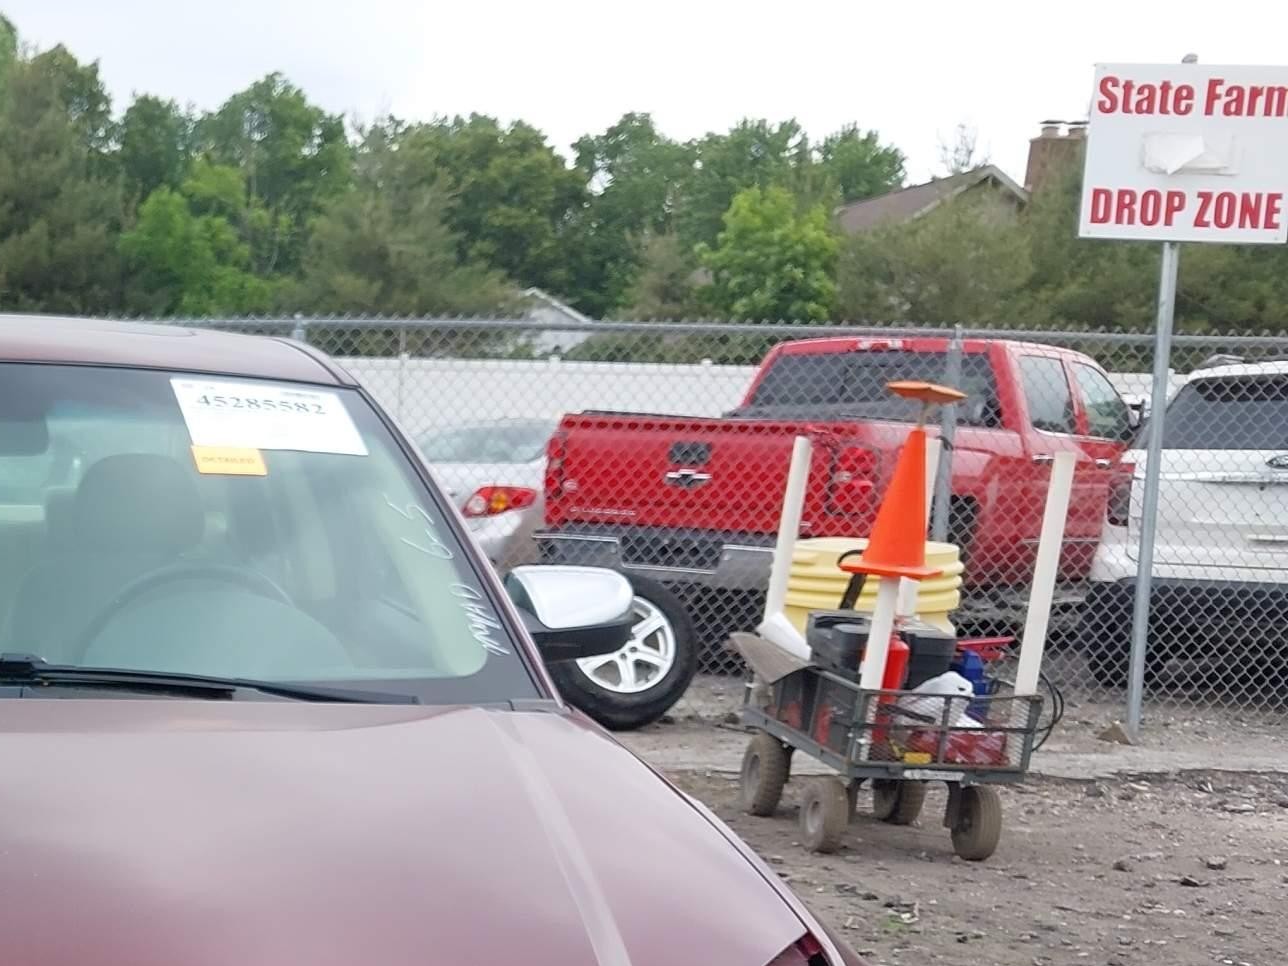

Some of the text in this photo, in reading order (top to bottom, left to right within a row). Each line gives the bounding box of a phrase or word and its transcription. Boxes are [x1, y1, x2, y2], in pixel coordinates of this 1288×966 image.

[1097, 75, 1288, 117] State Farm
[1089, 188, 1284, 229] DROP ZONE
[198, 394, 328, 415] 45285582
